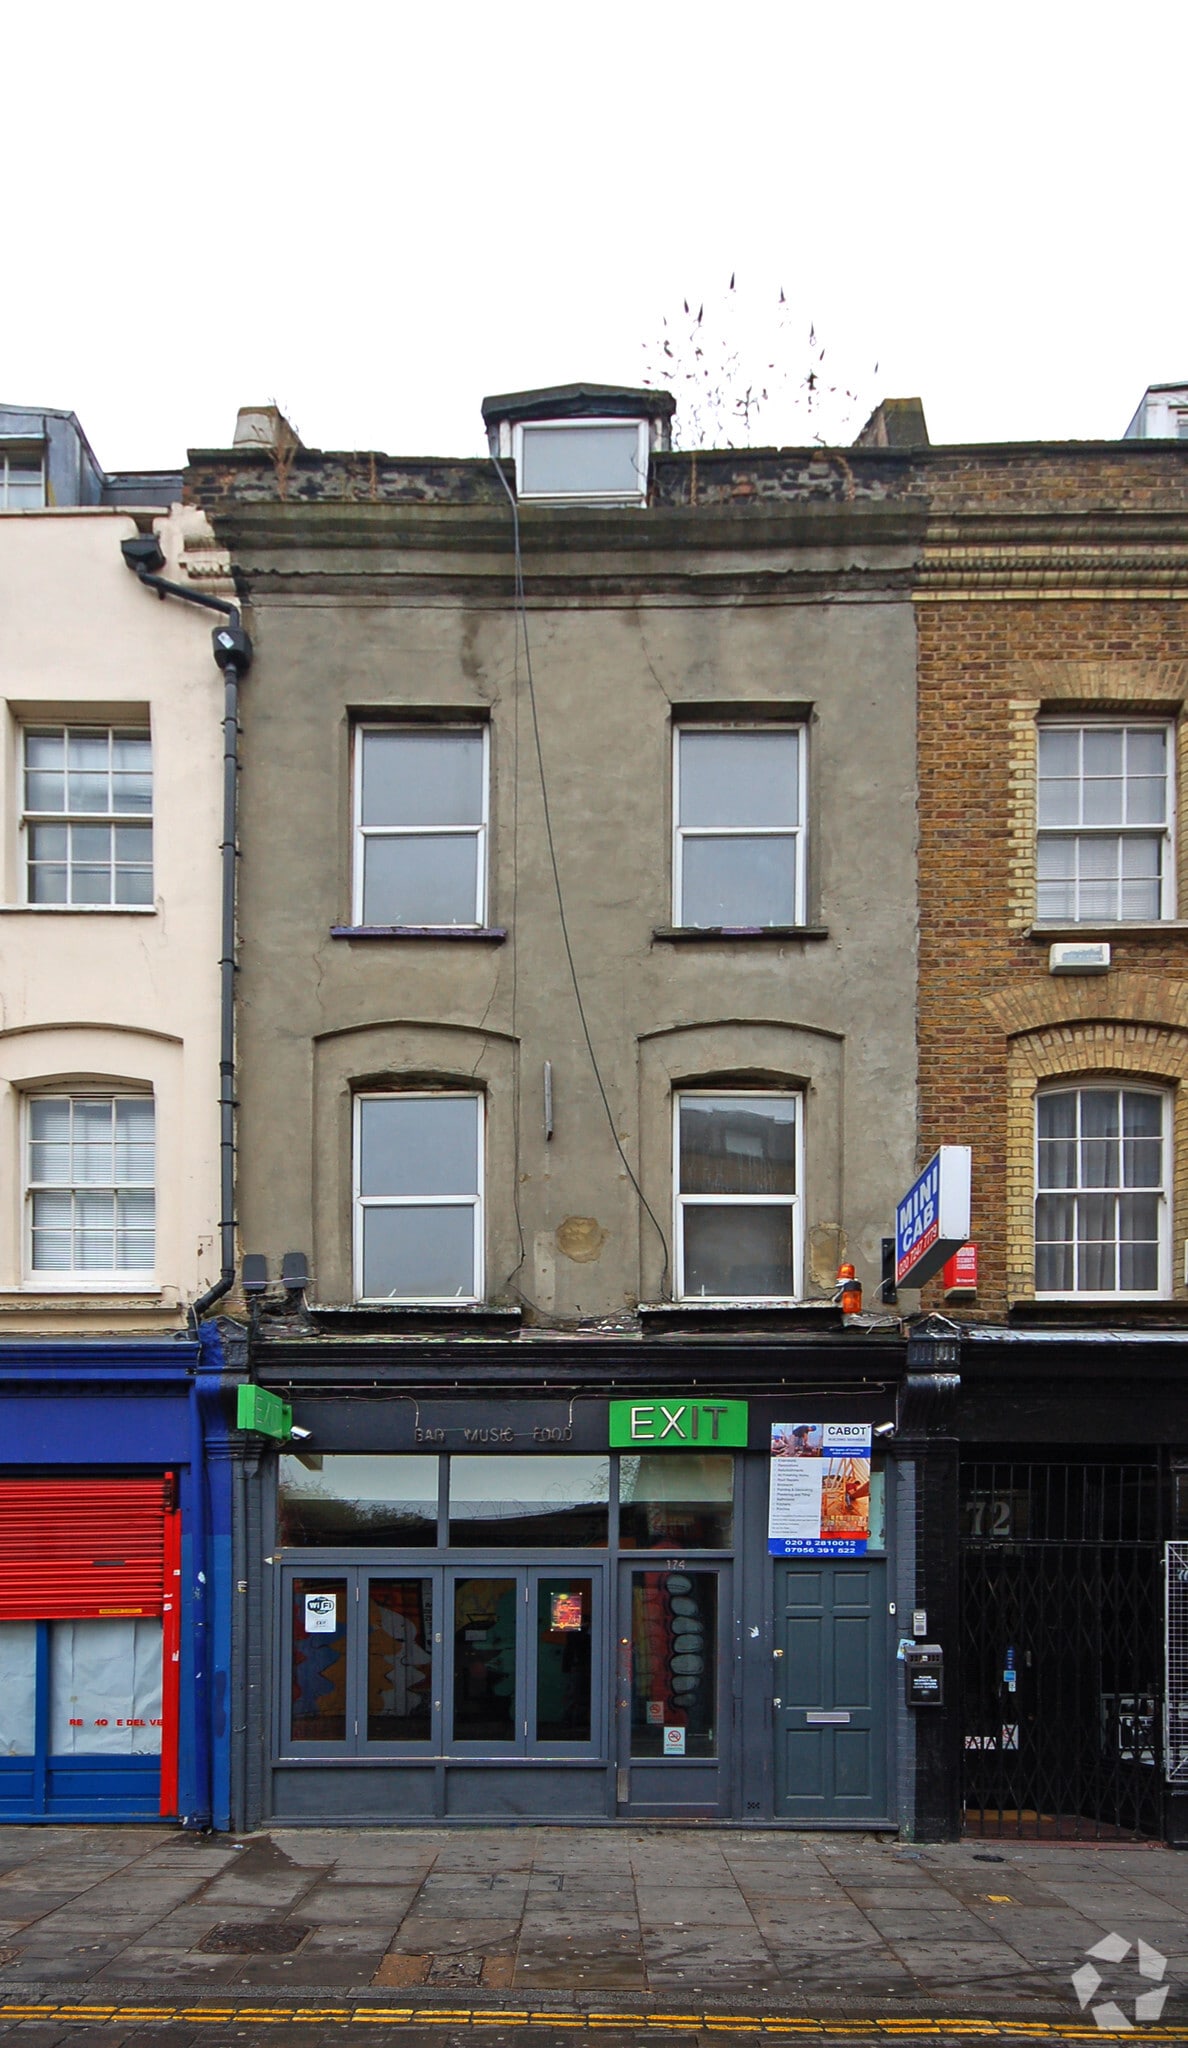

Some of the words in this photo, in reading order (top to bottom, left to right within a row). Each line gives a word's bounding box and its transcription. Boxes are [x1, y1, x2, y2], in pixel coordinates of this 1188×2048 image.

[900, 1165, 938, 1234] MINI
[902, 1201, 934, 1252] CAB
[899, 1255, 910, 1276] 020
[631, 1405, 728, 1440] EXIT
[828, 1426, 867, 1436] CABOT
[414, 1427, 445, 1443] BAR
[464, 1426, 514, 1442] MUSIC
[533, 1426, 573, 1442] FOOD
[666, 1560, 685, 1570] 174
[126, 1718, 147, 1727] DEL
